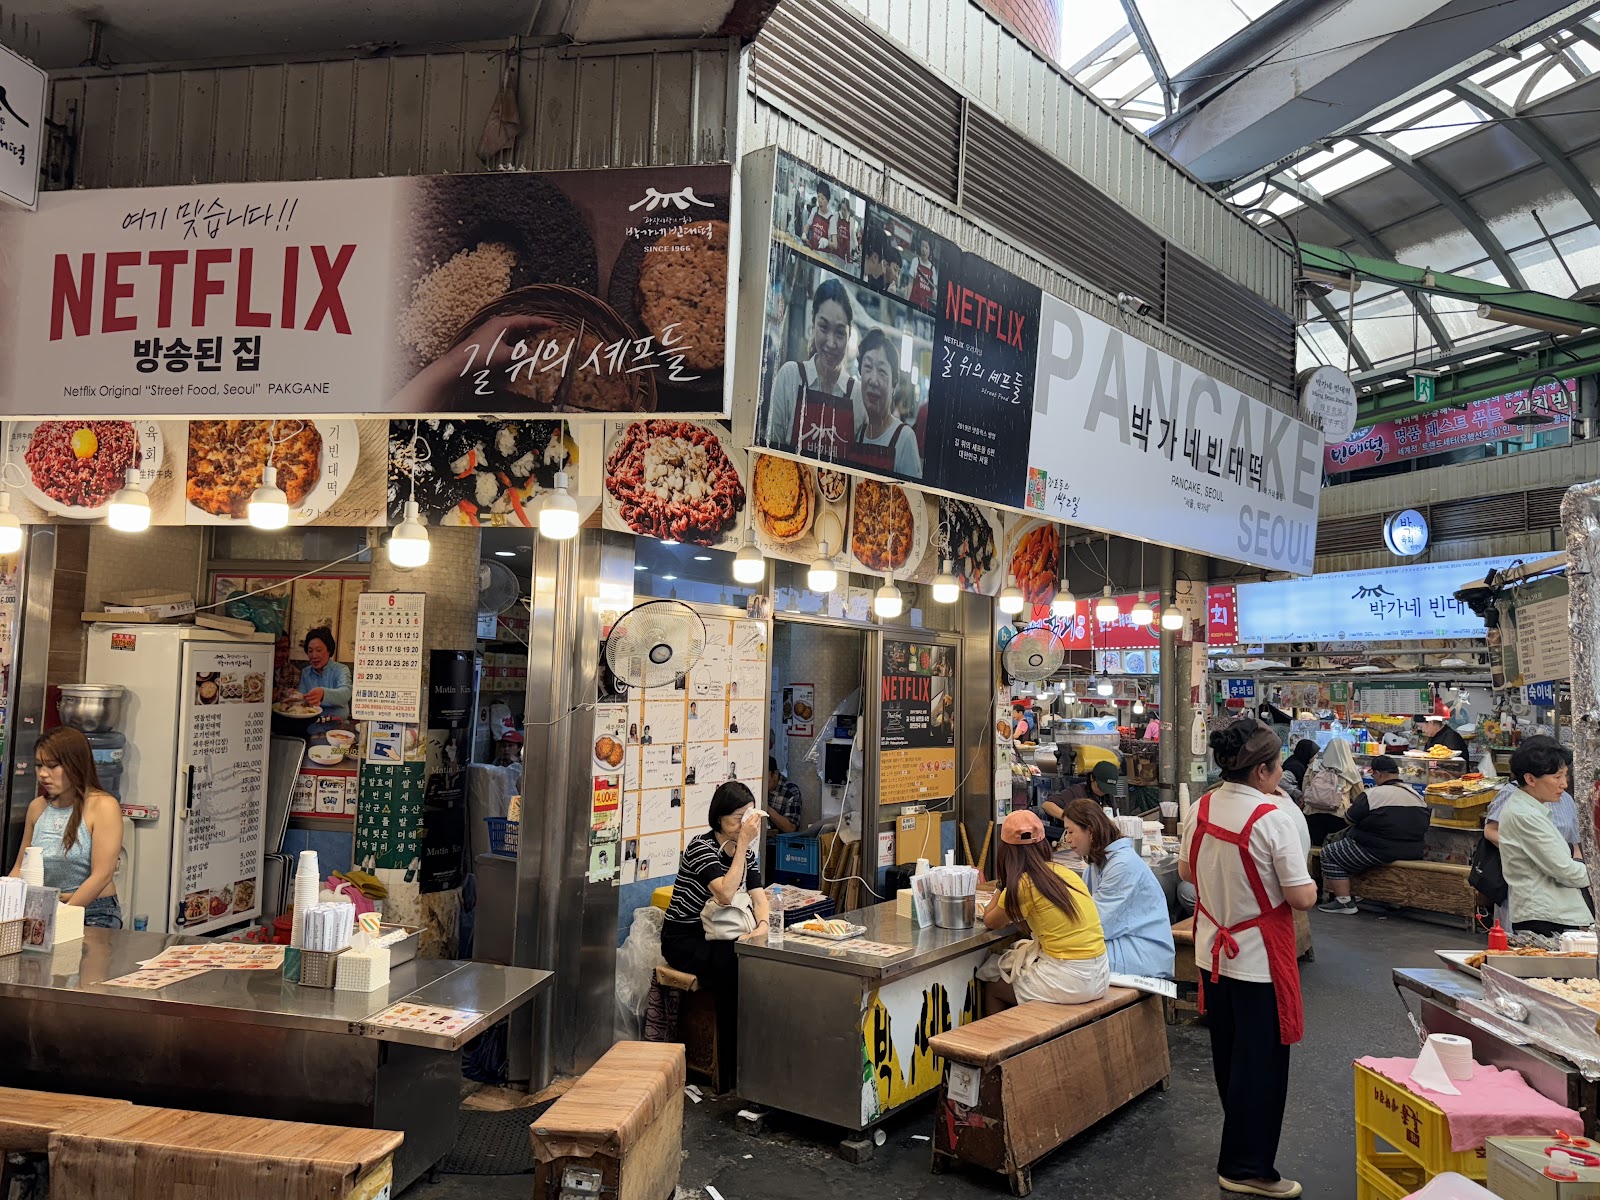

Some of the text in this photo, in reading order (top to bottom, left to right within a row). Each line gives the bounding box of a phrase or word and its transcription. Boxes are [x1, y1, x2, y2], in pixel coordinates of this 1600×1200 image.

[122, 208, 167, 231] 여기
[49, 244, 357, 342] NETFLIX
[945, 280, 1026, 352] NETFLIX
[943, 334, 965, 349] NETFLIX
[133, 335, 262, 374] 방송된 집
[459, 328, 507, 396] 길
[504, 337, 576, 383] 위의
[941, 345, 956, 378] 길
[959, 355, 985, 379] 위의
[63, 386, 97, 398] Netflix
[99, 385, 142, 399] Original
[187, 383, 220, 397] Food,
[267, 382, 330, 396] PAKGANE
[1033, 296, 1321, 511] PANCAKE
[1394, 424, 1422, 445] 명품
[1425, 414, 1469, 438] 패스트
[1472, 406, 1504, 428] 푸드
[145, 426, 159, 464] 육회
[1331, 435, 1384, 464] 빈대떡
[1170, 475, 1225, 502] PANCAKE, SEOUL
[1236, 504, 1315, 570] SEOUL
[388, 595, 395, 606] 6
[1369, 594, 1466, 621] 박가네 빈대
[1210, 602, 1228, 626] 회
[434, 685, 472, 695] Matin Kim
[881, 675, 931, 703] NETFLIX
[1230, 685, 1254, 697] 우리집
[1528, 682, 1553, 701] 숙이네
[244, 719, 264, 727] 10,000
[244, 727, 264, 736] 10,000
[244, 735, 263, 744] 10,000
[402, 766, 412, 776] 두
[431, 765, 453, 775] Matin
[241, 784, 261, 793] 25,000
[400, 792, 409, 801] 세
[240, 849, 257, 860] 5,000
[426, 847, 449, 857] Matin
[239, 858, 257, 868] 5,000
[239, 866, 256, 876] 7,000
